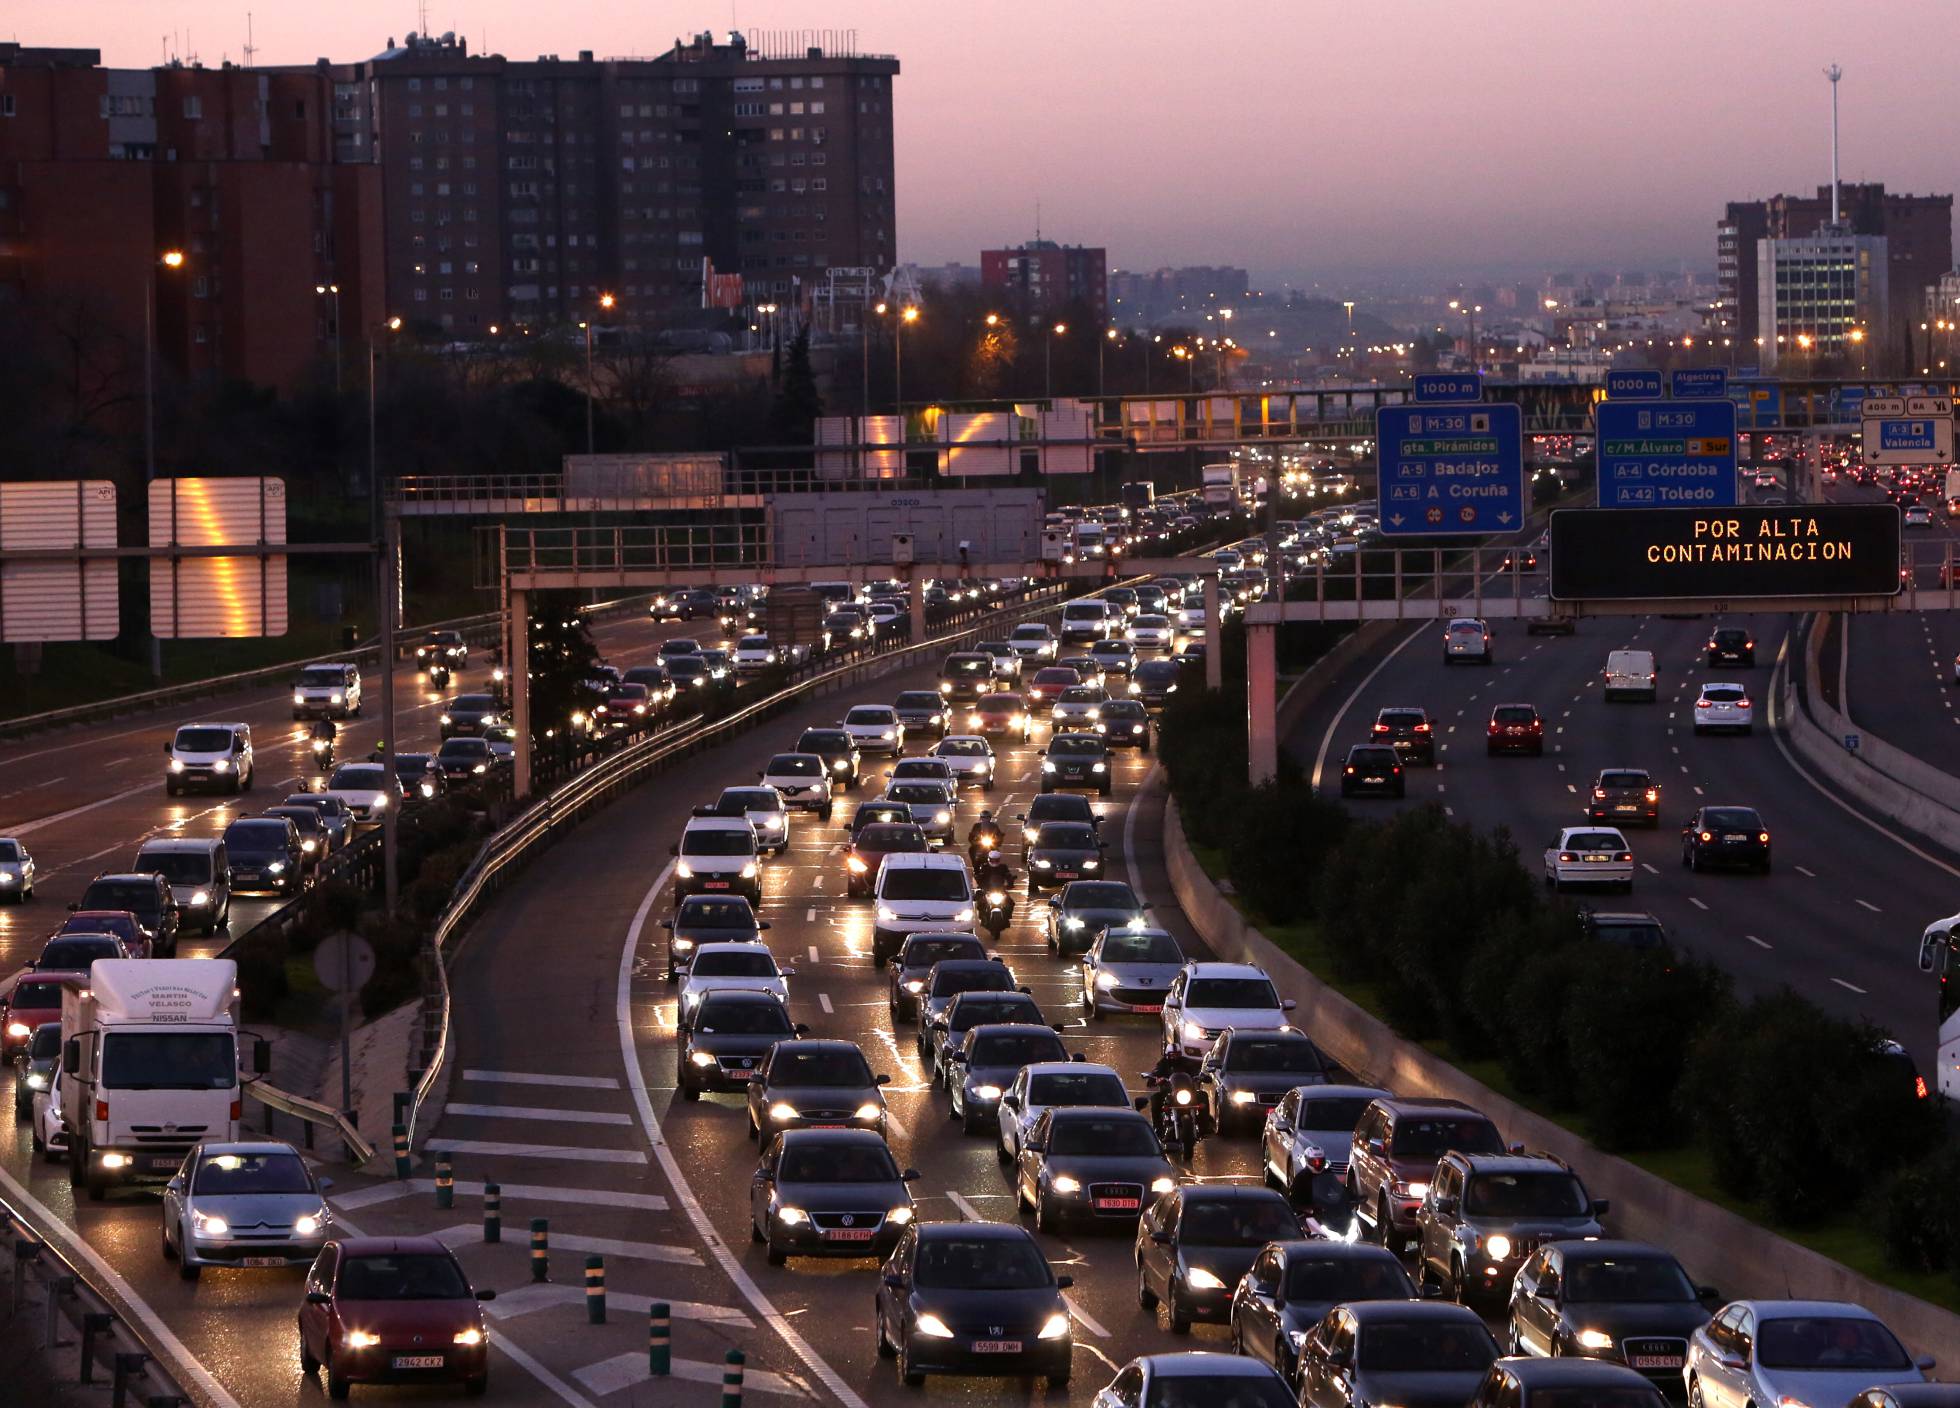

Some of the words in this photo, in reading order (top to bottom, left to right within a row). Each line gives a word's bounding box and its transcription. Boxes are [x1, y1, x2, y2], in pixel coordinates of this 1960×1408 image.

[1677, 373, 1721, 383] Algeciras
[1422, 383, 1456, 393] 1000
[1462, 384, 1473, 393] m
[1612, 380, 1643, 390] 1000
[1647, 381, 1658, 389] m
[1428, 418, 1463, 429] M-30
[1658, 414, 1693, 425] M-30
[1891, 425, 1907, 433] A-3
[1434, 440, 1496, 451] Pirámides
[1706, 442, 1727, 452] Sur
[1884, 438, 1930, 448] Valencia
[1401, 464, 1423, 475] A-5
[1435, 461, 1499, 477] Badajoz
[1617, 467, 1639, 476] A-4
[1648, 463, 1718, 476] Córdoba
[1393, 486, 1418, 497] A-6
[1427, 485, 1439, 498] A
[1449, 484, 1508, 497] Coruña
[1620, 489, 1652, 499] A-42
[1659, 487, 1714, 499] Toledo
[1695, 520, 1740, 538] POR
[1759, 518, 1819, 537] ALTA
[1647, 541, 1852, 562] CONTAMINACION
